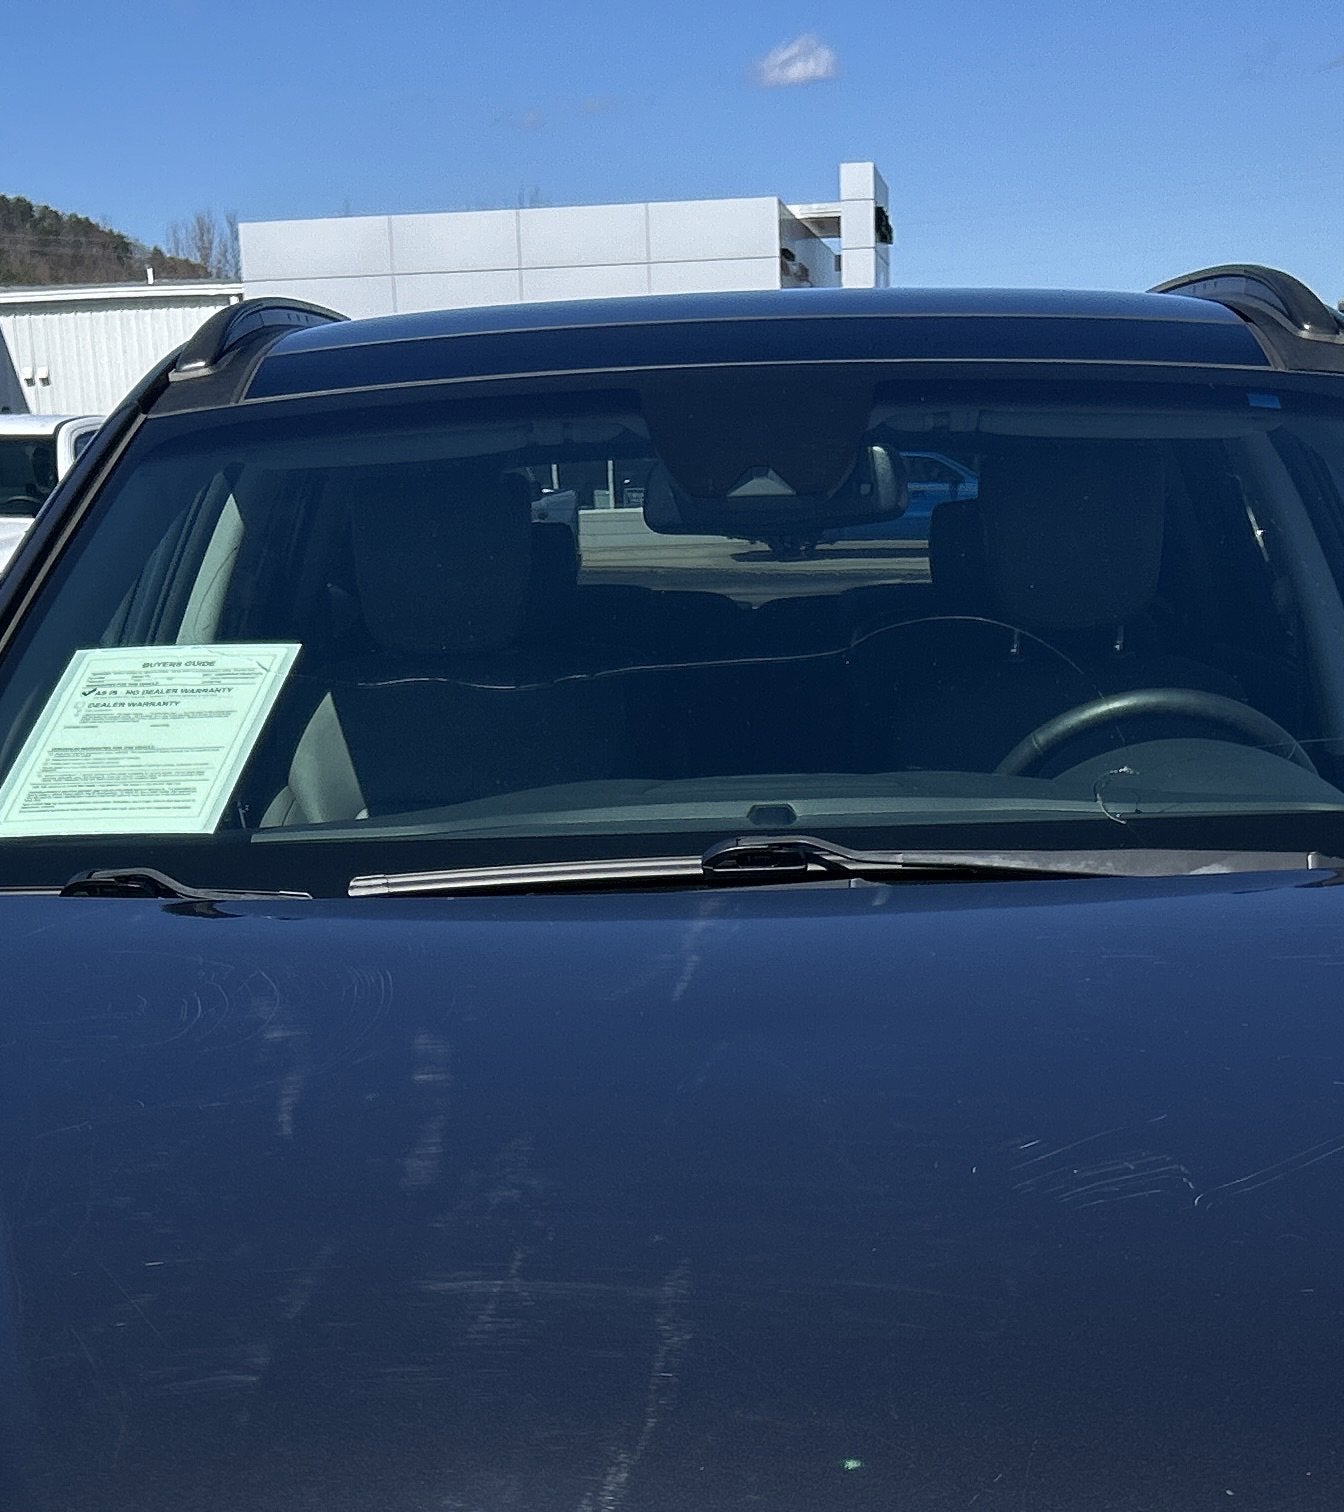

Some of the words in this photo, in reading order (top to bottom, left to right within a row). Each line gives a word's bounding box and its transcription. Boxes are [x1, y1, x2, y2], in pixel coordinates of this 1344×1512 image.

[142, 661, 182, 669] BUYERS
[184, 660, 216, 668] GUIDE
[142, 687, 178, 695] DEALER
[87, 701, 126, 709] DEALER
[128, 700, 180, 708] WARRANTY
